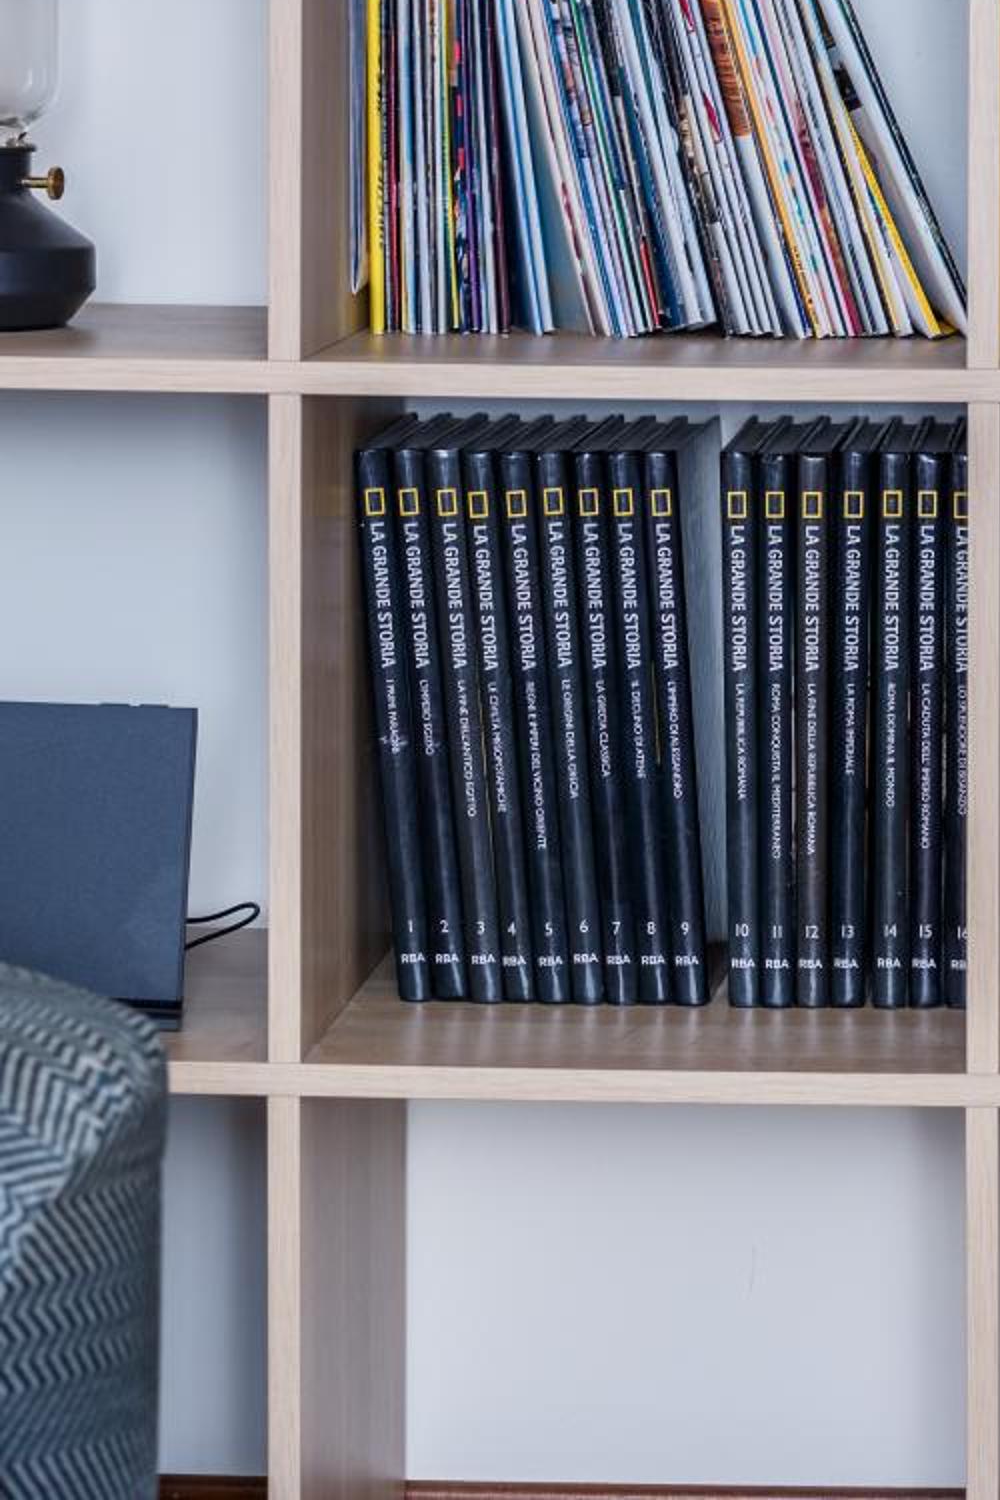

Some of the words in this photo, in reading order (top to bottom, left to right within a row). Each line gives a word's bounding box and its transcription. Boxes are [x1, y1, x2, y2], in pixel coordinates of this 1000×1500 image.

[369, 521, 386, 543] LA
[403, 521, 420, 543] LA
[442, 522, 458, 544] LA
[473, 524, 489, 546] LA
[511, 523, 527, 545] LA
[547, 521, 564, 543] LA
[583, 522, 599, 544] LA
[617, 522, 633, 544] LA
[655, 522, 671, 544] LA
[730, 525, 745, 546] LA
[767, 525, 783, 546] LA
[805, 525, 820, 546] LA
[846, 524, 861, 546] LA
[885, 524, 900, 545] LA
[919, 524, 935, 545] LA
[955, 525, 968, 547] LA
[371, 545, 391, 609] GRANDE
[405, 545, 425, 609] GRANDE
[443, 546, 463, 609] GRANDE
[475, 548, 494, 611] GRANDE
[513, 547, 532, 611] GRANDE
[549, 545, 569, 608] GRANDE
[584, 545, 603, 609] GRANDE
[619, 545, 638, 609] GRANDE
[657, 545, 675, 610] GRANDE
[731, 548, 747, 612] GRANDE
[767, 548, 783, 612] GRANDE
[804, 548, 820, 612] GRANDE
[844, 548, 861, 612] GRANDE
[884, 547, 900, 611] GRANDE
[919, 547, 935, 611] GRANDE
[955, 549, 968, 613] GRANDE
[377, 611, 397, 669] STORIA
[411, 611, 431, 669] STORIA
[449, 612, 468, 669] STORIA
[480, 614, 499, 671] STORIA
[518, 613, 537, 671] STORIA
[554, 611, 573, 669] STORIA
[589, 612, 607, 670] STORIA
[623, 612, 642, 670] STORIA
[660, 613, 679, 670] STORIA
[731, 615, 747, 672] STORIA
[768, 615, 784, 672] STORIA
[804, 615, 820, 673] STORIA
[844, 615, 860, 672] STORIA
[884, 615, 900, 672] STORIA
[919, 615, 935, 672] STORIA
[955, 616, 968, 673] STORIA
[771, 683, 781, 712] ROMA
[735, 698, 746, 754] REPUBBLICA
[770, 715, 781, 772] CONQUISTA
[737, 756, 747, 800] ROMANA
[771, 785, 781, 858] MEDITERRANEO
[407, 919, 414, 933] 1
[439, 919, 450, 934] 2
[476, 920, 486, 936] 3
[507, 922, 517, 936] 4
[545, 921, 554, 937] 5
[579, 919, 589, 934] 6
[611, 920, 622, 936] 7
[647, 920, 657, 935] 8
[680, 921, 691, 936] 9
[735, 922, 750, 938] 10
[772, 924, 783, 940] 11
[805, 924, 820, 940] 12
[841, 923, 855, 940] 13
[884, 924, 897, 938] 14
[919, 923, 933, 939] 15
[472, 954, 496, 967] RBA
[574, 953, 598, 967] RBA
[732, 958, 755, 971] RBA
[878, 956, 901, 970] RBA
